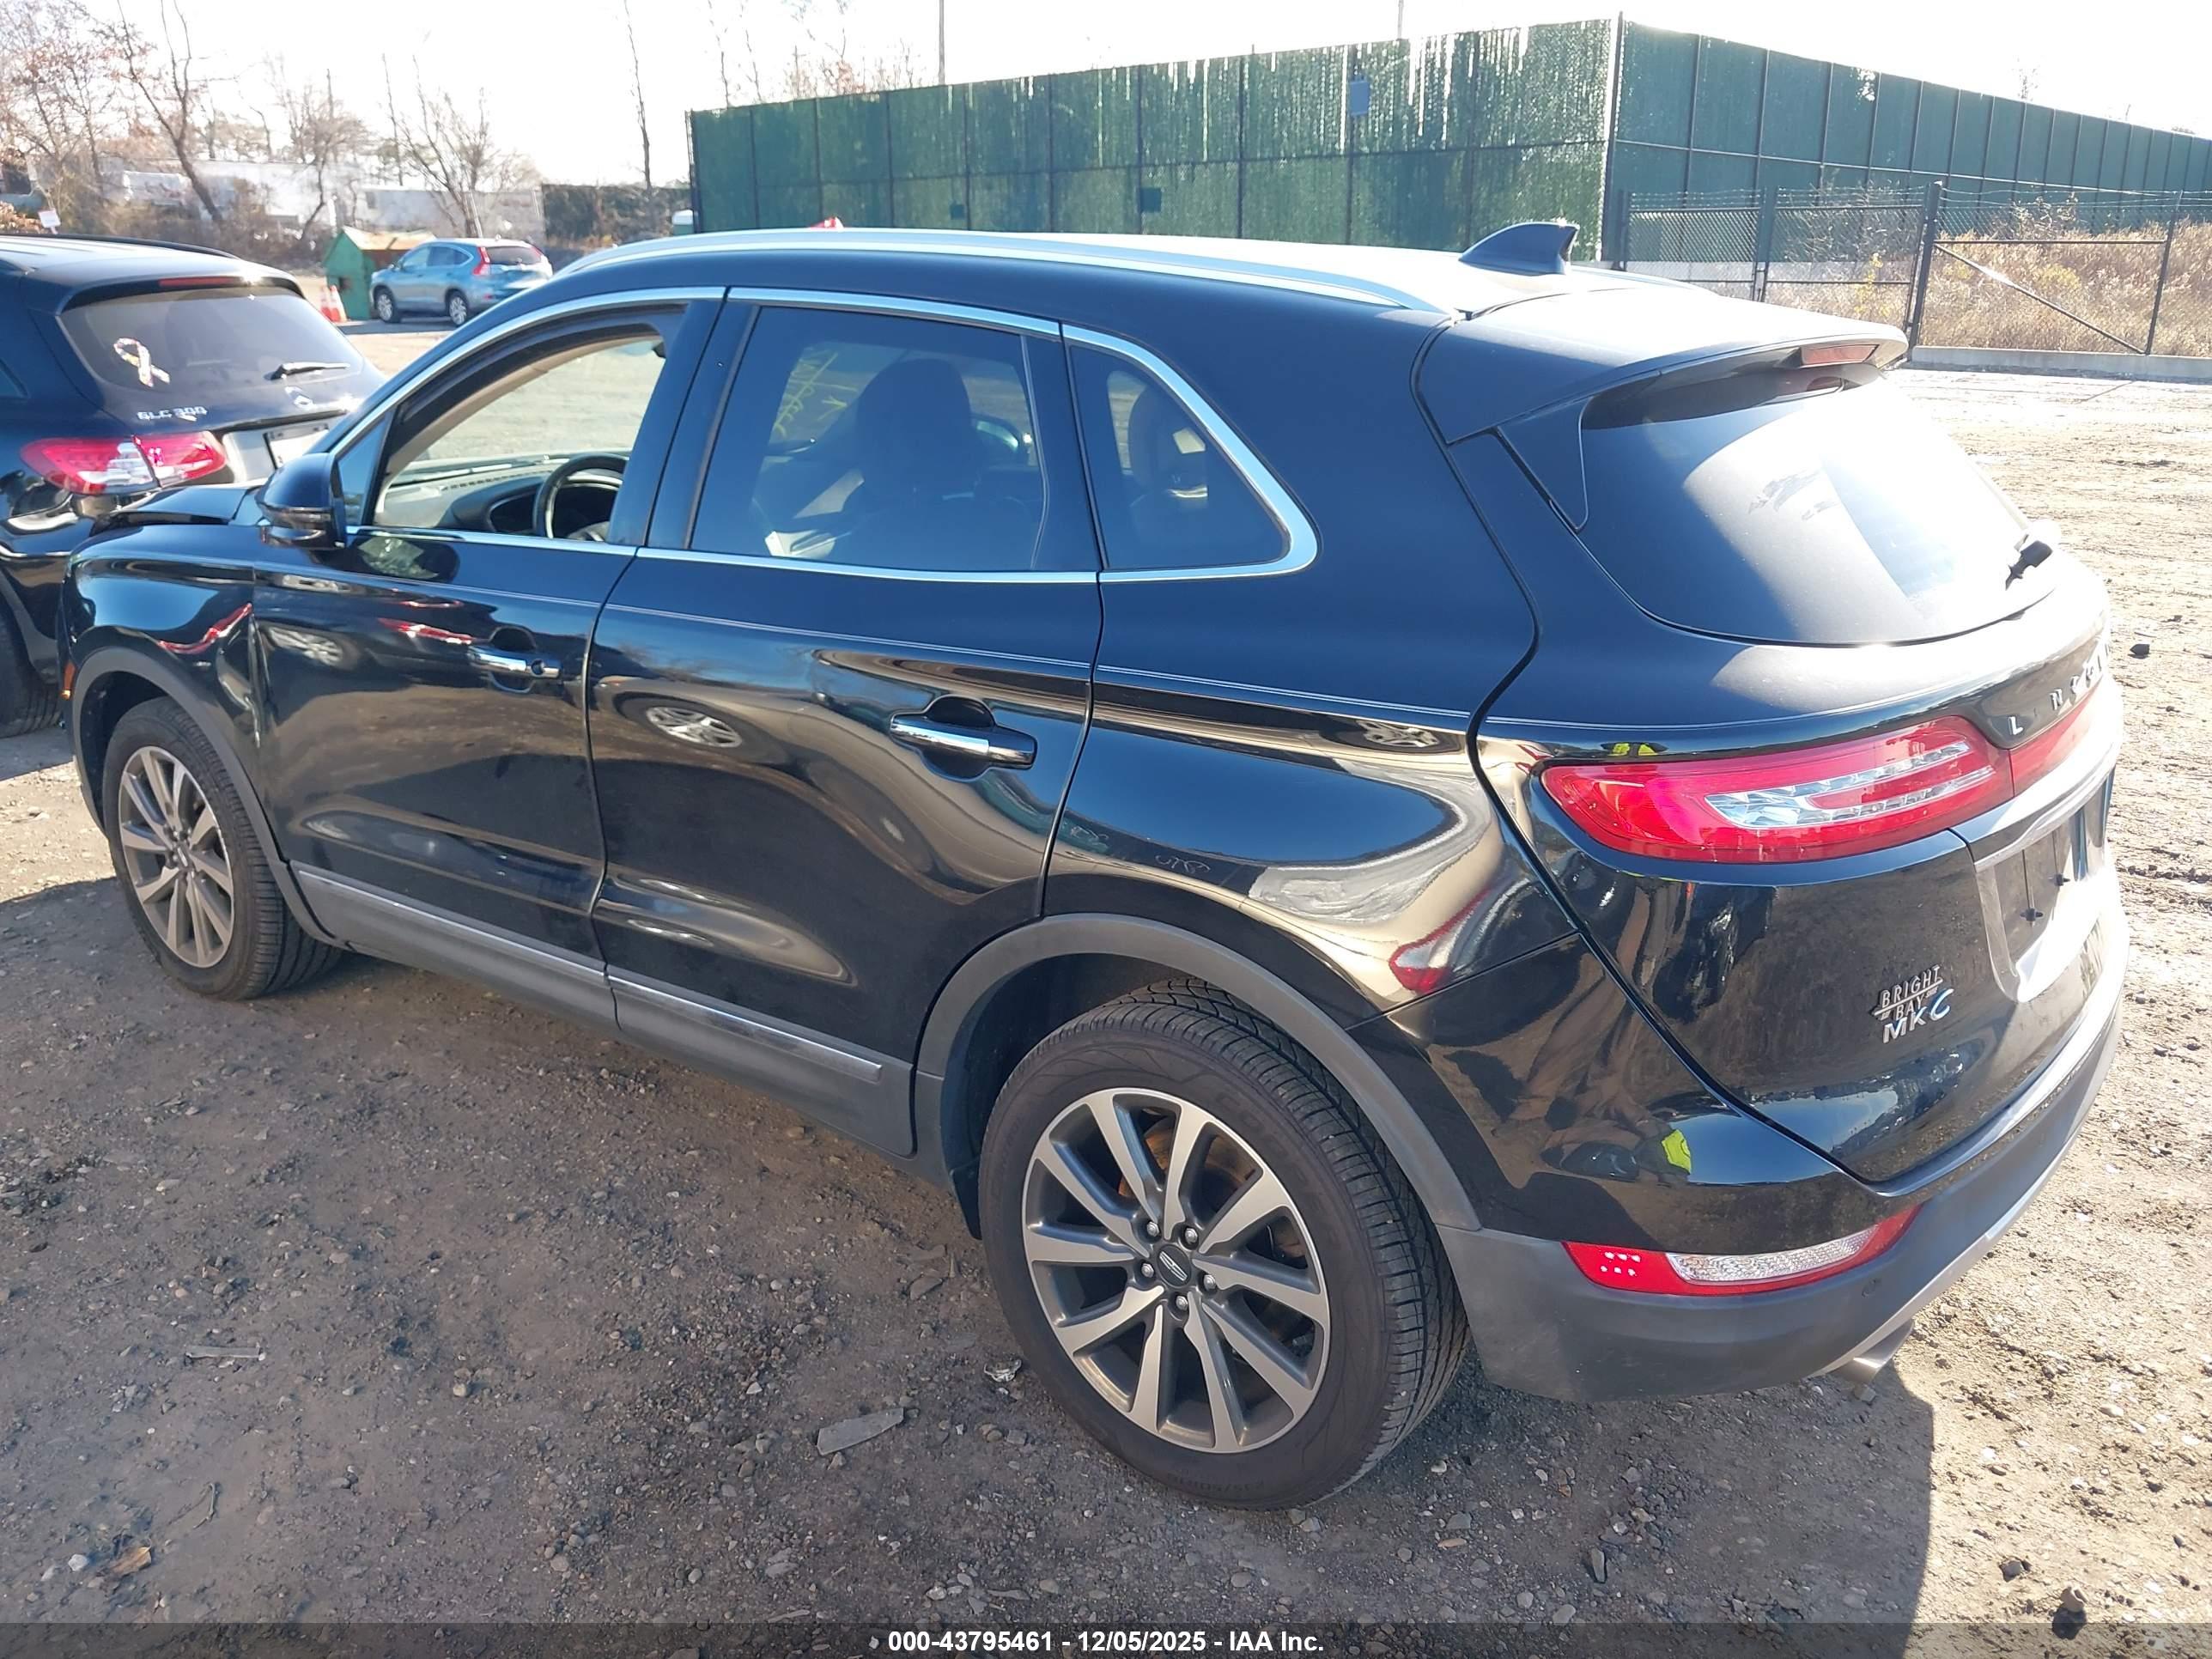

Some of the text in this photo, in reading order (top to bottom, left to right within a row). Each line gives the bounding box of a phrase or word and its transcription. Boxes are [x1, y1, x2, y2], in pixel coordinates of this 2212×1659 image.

[137, 410, 173, 420] GLC
[2008, 642, 2110, 735] LINC
[1881, 964, 1941, 1009] BRIGHT
[1895, 995, 1924, 1021] BAY
[1883, 988, 1954, 1043] MKC
